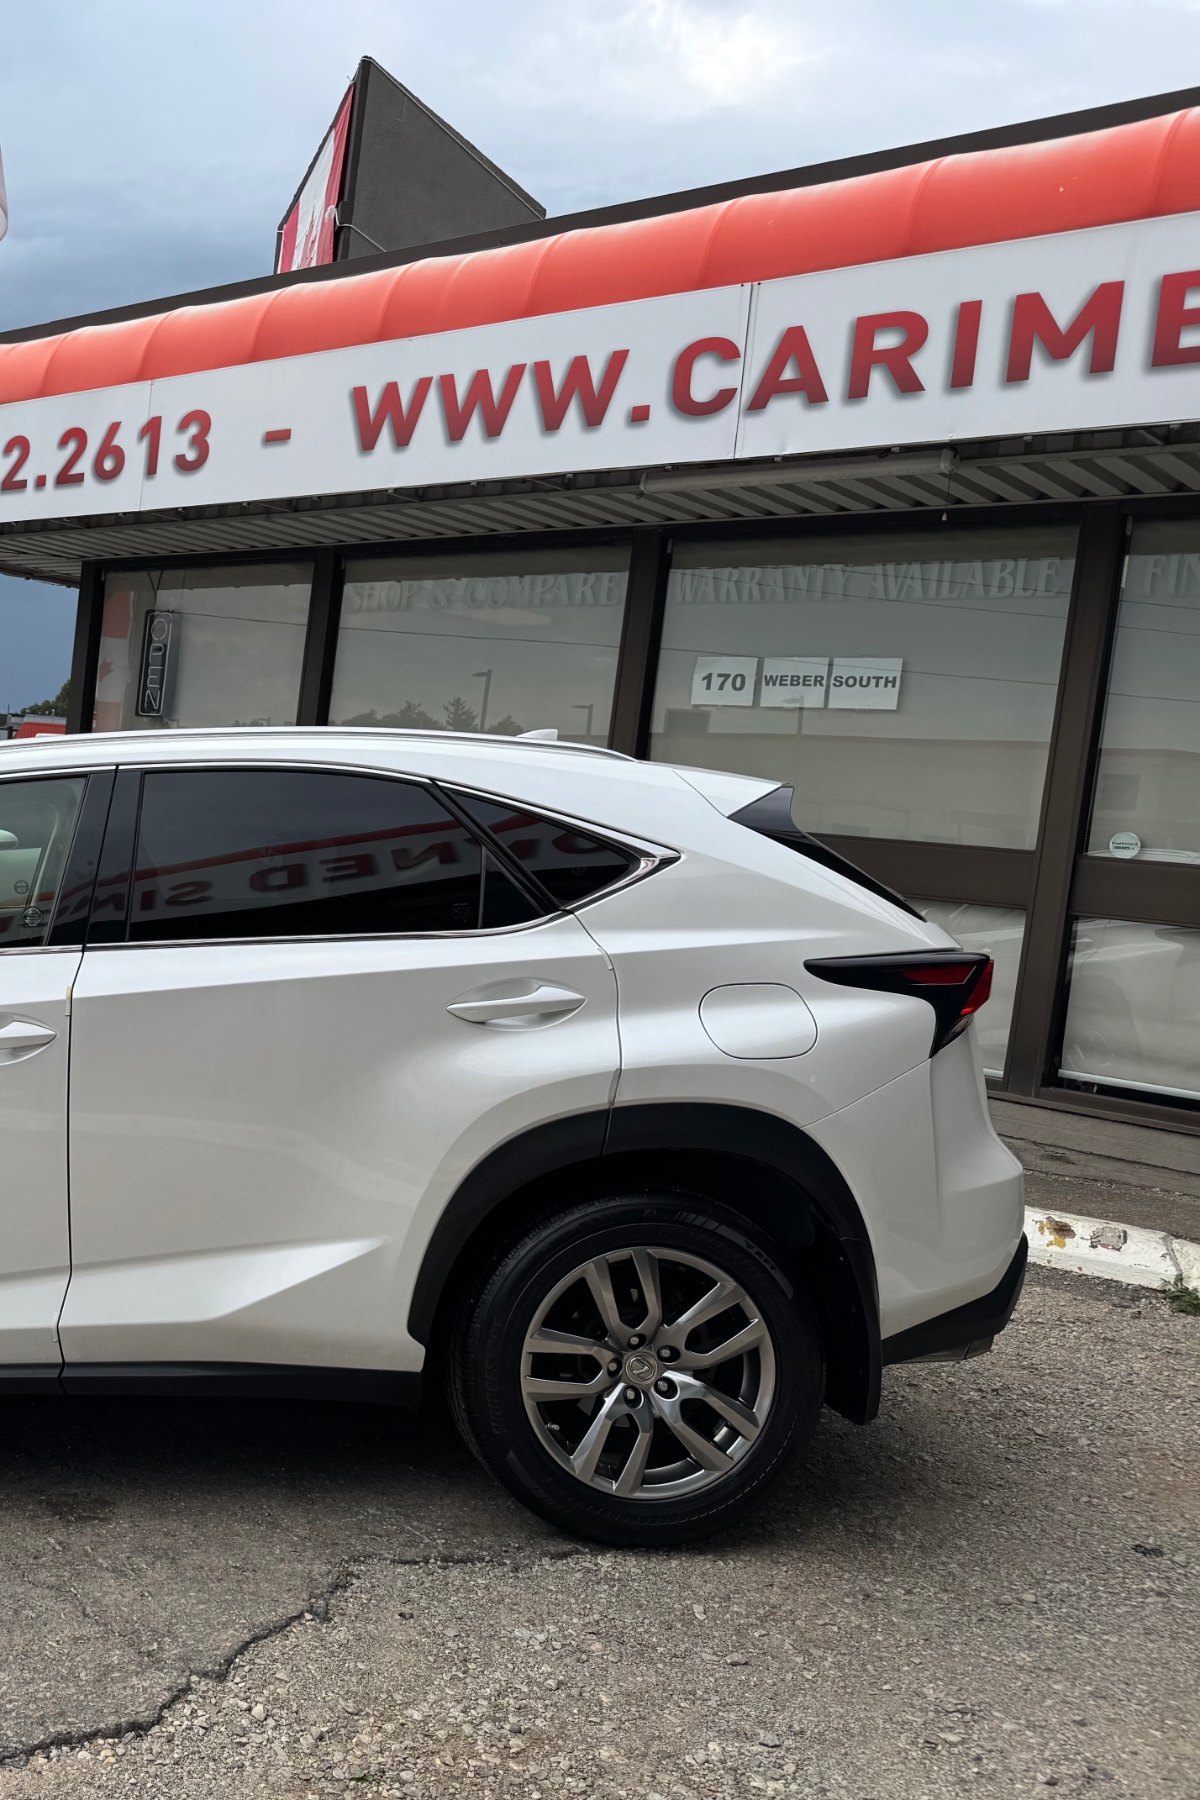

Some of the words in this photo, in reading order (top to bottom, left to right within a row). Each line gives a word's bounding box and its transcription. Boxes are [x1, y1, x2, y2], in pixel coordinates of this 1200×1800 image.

[867, 557, 1060, 600] AVAILABLE
[700, 672, 746, 692] 170
[763, 674, 825, 688] WEBER
[832, 675, 897, 690] SOUTH
